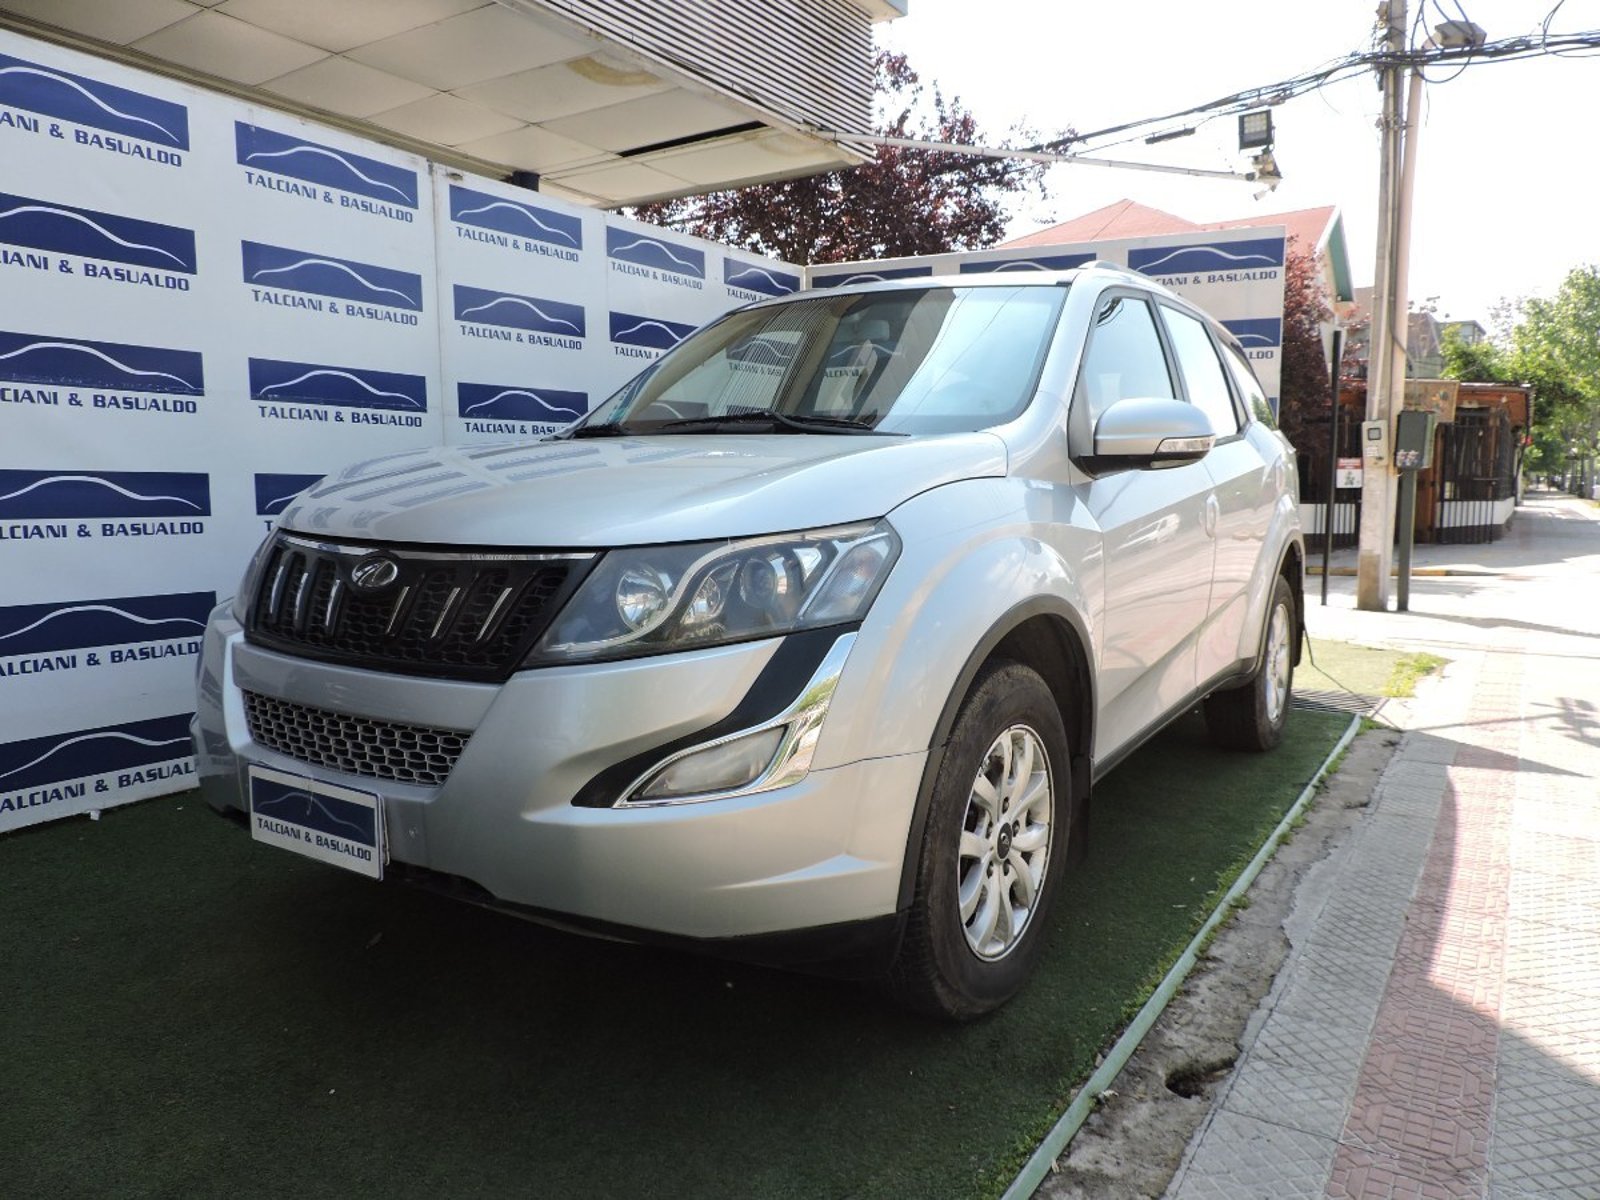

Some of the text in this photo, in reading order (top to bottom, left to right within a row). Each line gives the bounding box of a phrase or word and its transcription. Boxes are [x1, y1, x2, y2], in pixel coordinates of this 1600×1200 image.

[50, 124, 64, 139] &
[75, 129, 182, 167] BASUALDO
[245, 171, 413, 223] TALCIANI & BASUALDO
[456, 226, 579, 262] TALCIANI & BASUALDO
[59, 260, 74, 274] &
[84, 263, 189, 291] BASUALDO
[611, 261, 649, 278] TALCIANI
[662, 273, 703, 290] BASUALDO
[1193, 276, 1201, 284] &
[1208, 270, 1277, 284] BASUALDO
[252, 289, 418, 326] TALCIANI & BASUALDO
[726, 288, 757, 301] TALCIANI
[460, 324, 582, 350] TALCIANI & BASUALDO
[614, 346, 652, 359] TALCIANI
[68, 393, 83, 407] &
[93, 394, 197, 413] BASUALDO
[259, 405, 422, 427] TALCIANI & BASUALDO
[465, 422, 515, 435] TALCIANI
[520, 425, 527, 434] &
[77, 524, 91, 537] &
[102, 522, 204, 537] BASUALDO
[87, 653, 100, 666] &
[111, 641, 199, 664] BASUALD
[95, 779, 109, 792] &
[118, 762, 195, 789] BASUAL
[257, 817, 371, 861] TALCIANI & BASUALDO
